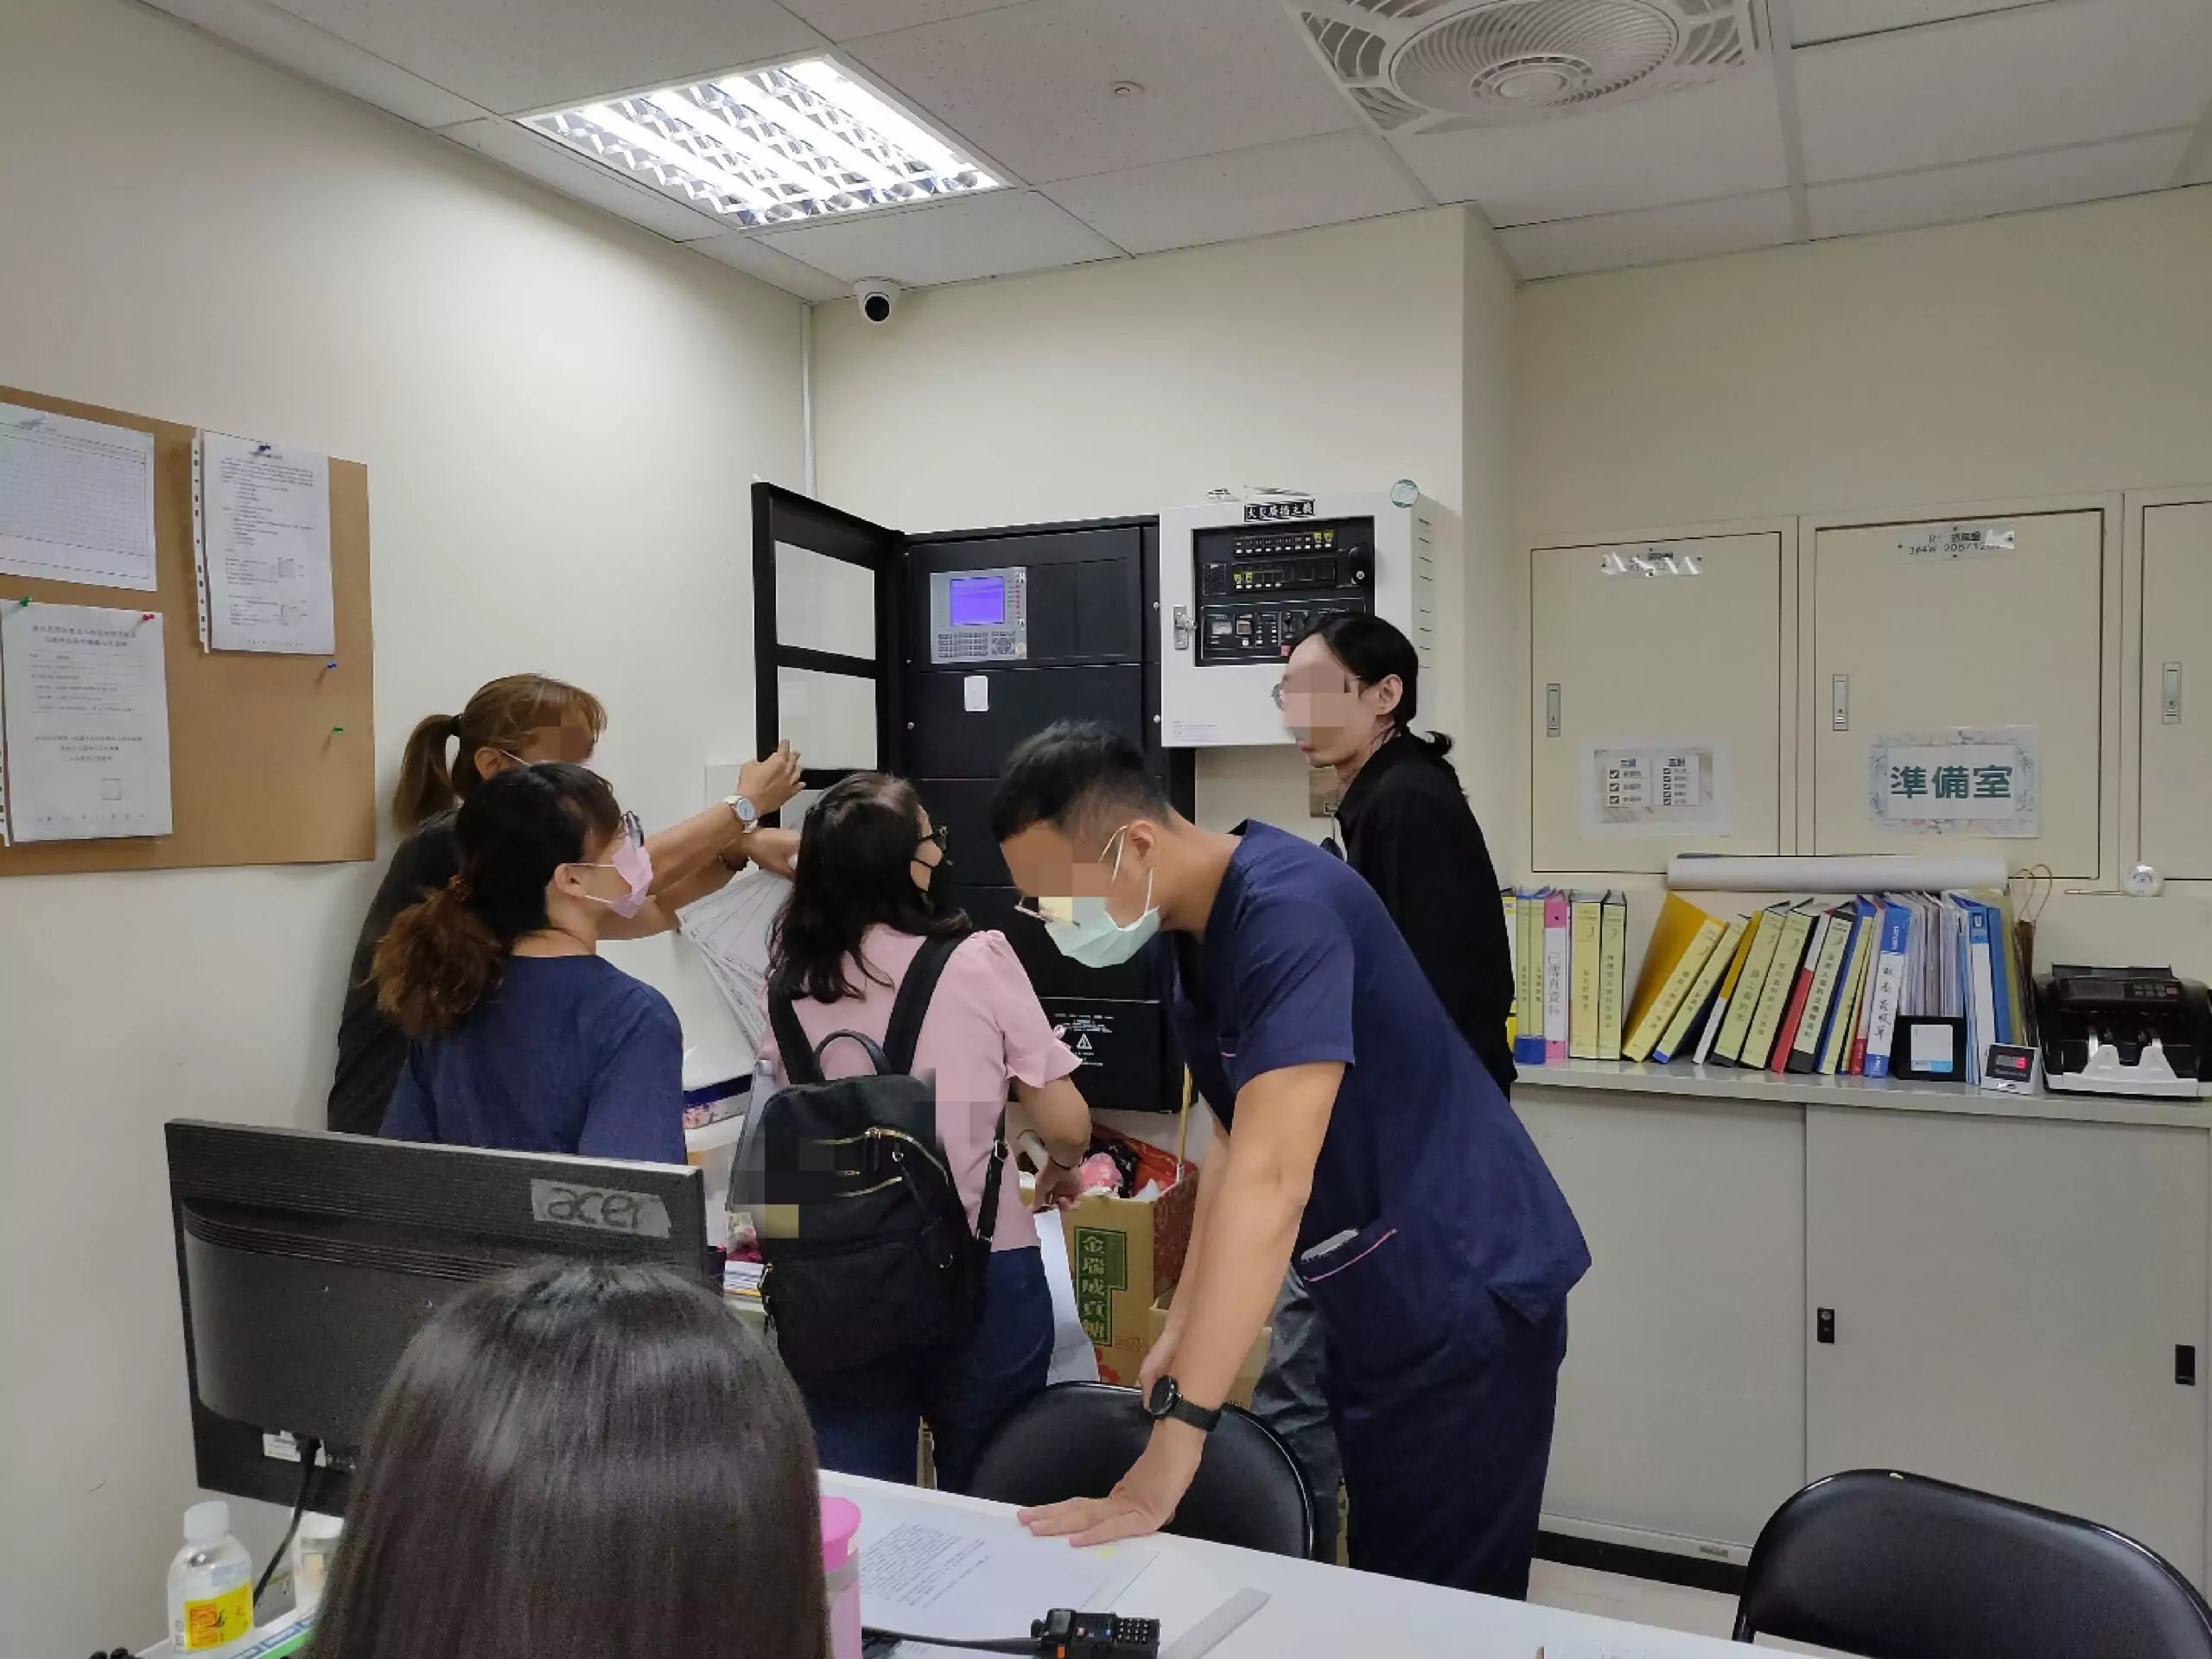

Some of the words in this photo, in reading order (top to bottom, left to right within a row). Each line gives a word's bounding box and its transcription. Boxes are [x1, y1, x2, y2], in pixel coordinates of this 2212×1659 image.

[1890, 764, 2013, 799] 準備室
[547, 1186, 641, 1230] acer
